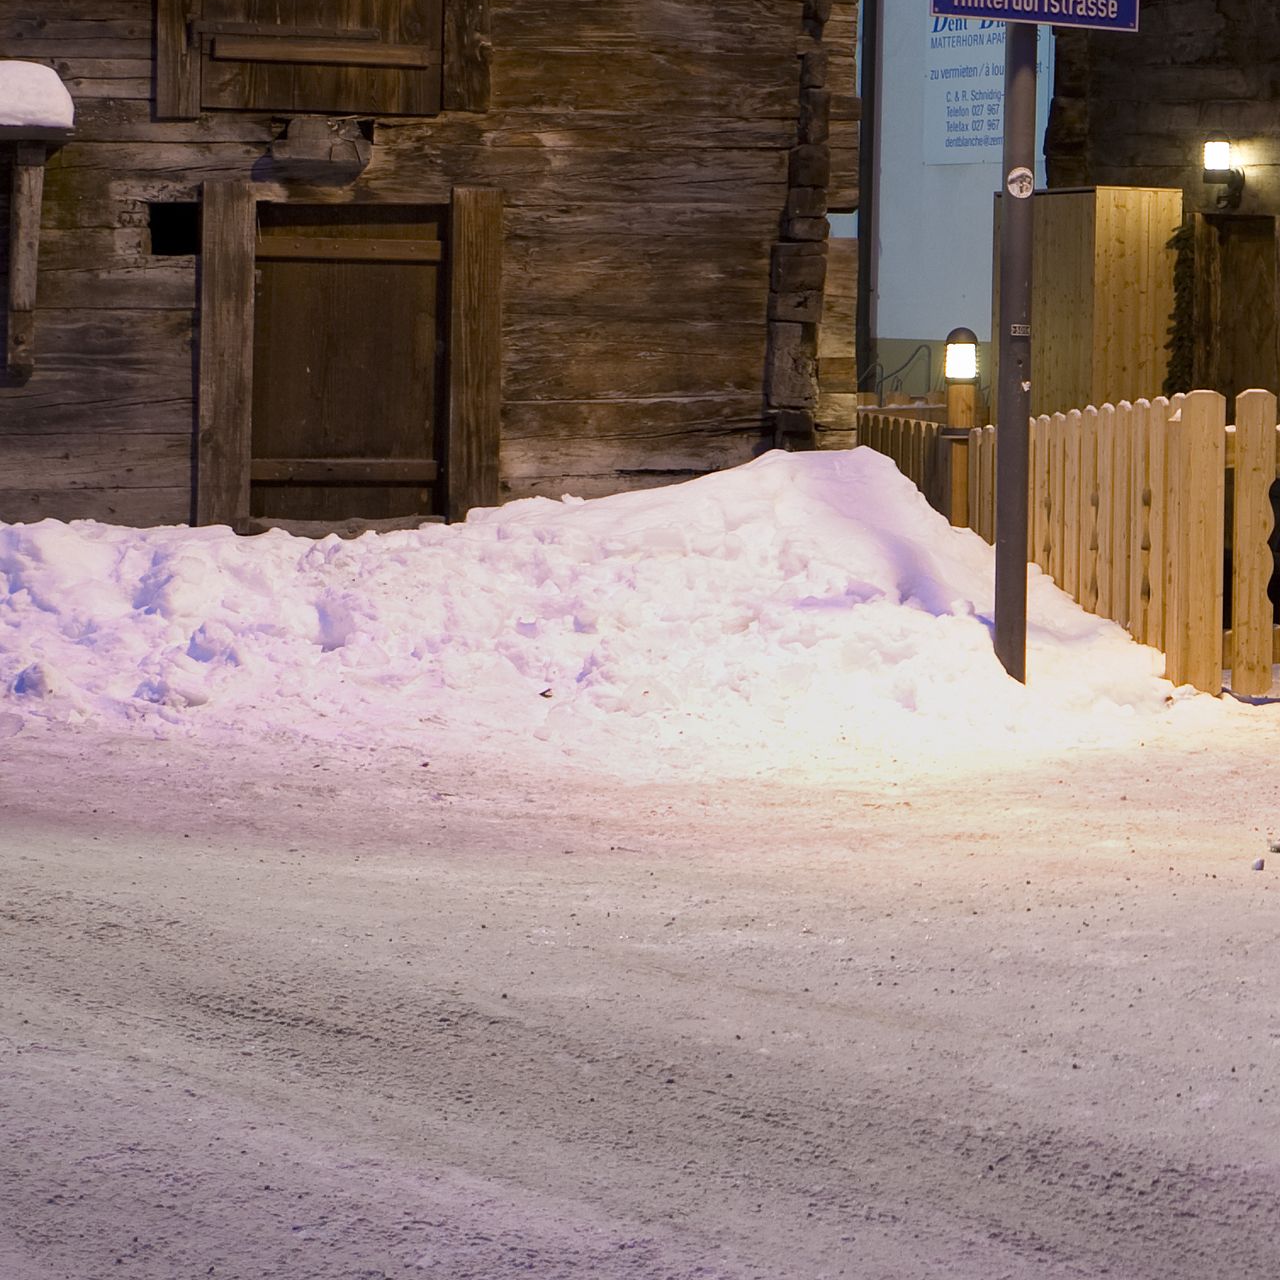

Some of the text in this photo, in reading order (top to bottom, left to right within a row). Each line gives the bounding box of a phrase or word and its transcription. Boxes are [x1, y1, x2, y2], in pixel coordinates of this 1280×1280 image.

[930, 35, 985, 49] MATTERHORN
[930, 70, 939, 81] zu
[941, 64, 978, 79] vermieten
[946, 103, 1000, 117] Telefon 027 967
[946, 118, 1000, 132] Telefax 027 967
